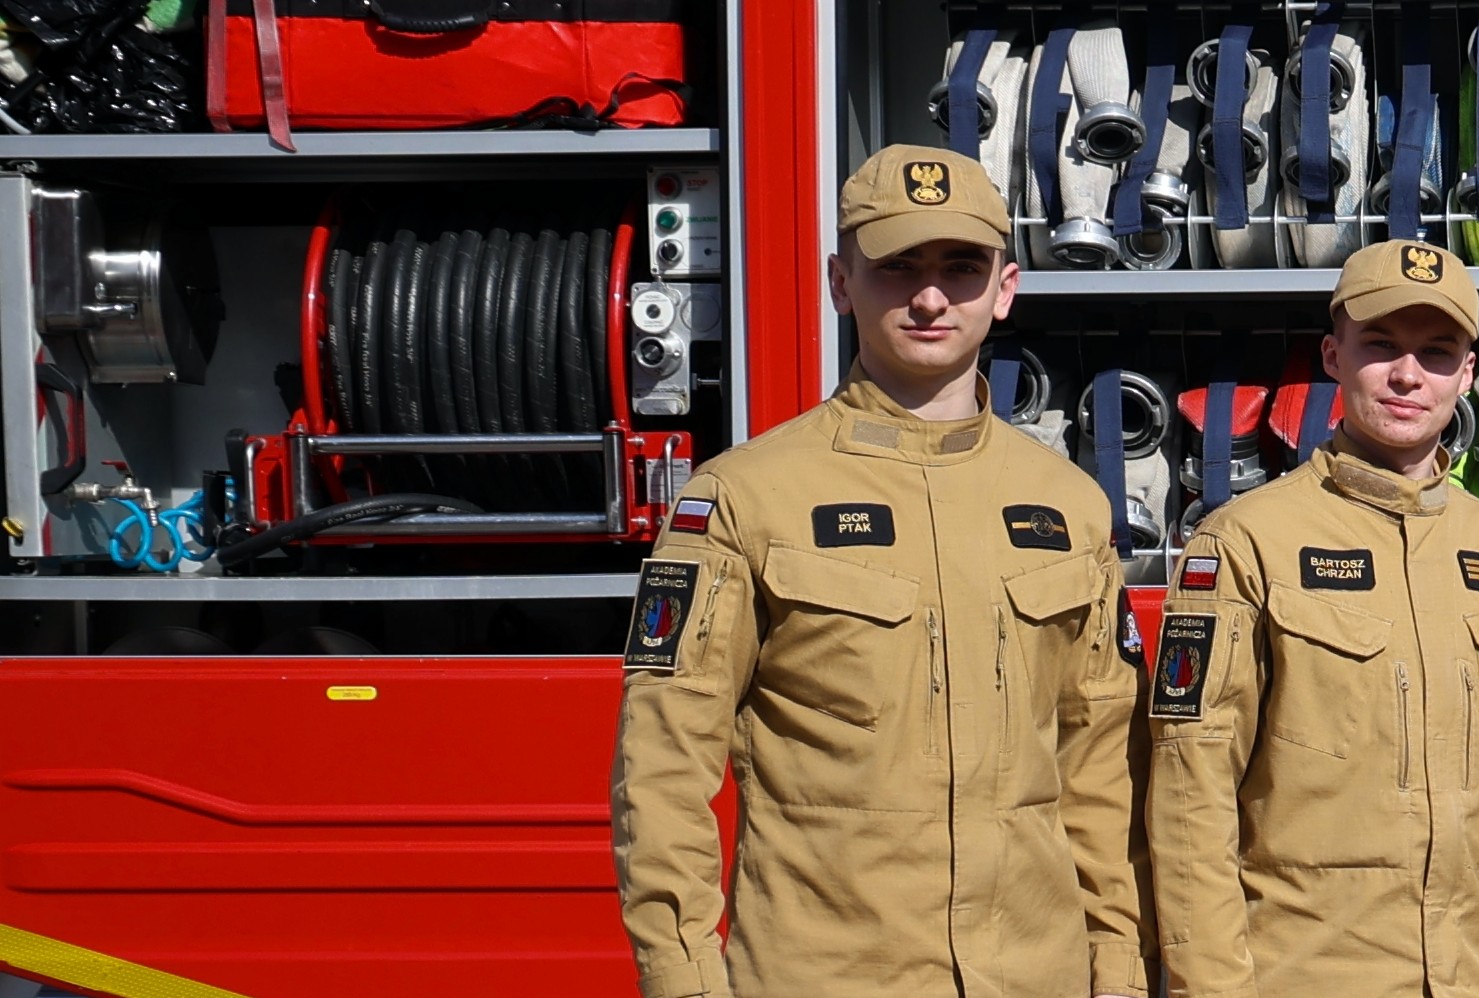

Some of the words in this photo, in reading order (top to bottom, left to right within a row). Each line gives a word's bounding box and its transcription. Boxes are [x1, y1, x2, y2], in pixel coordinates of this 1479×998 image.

[838, 512, 869, 523] IGOR
[838, 522, 872, 534] PTAK
[1310, 556, 1366, 569] BARTOSZ
[1315, 567, 1362, 579] CHRZAN
